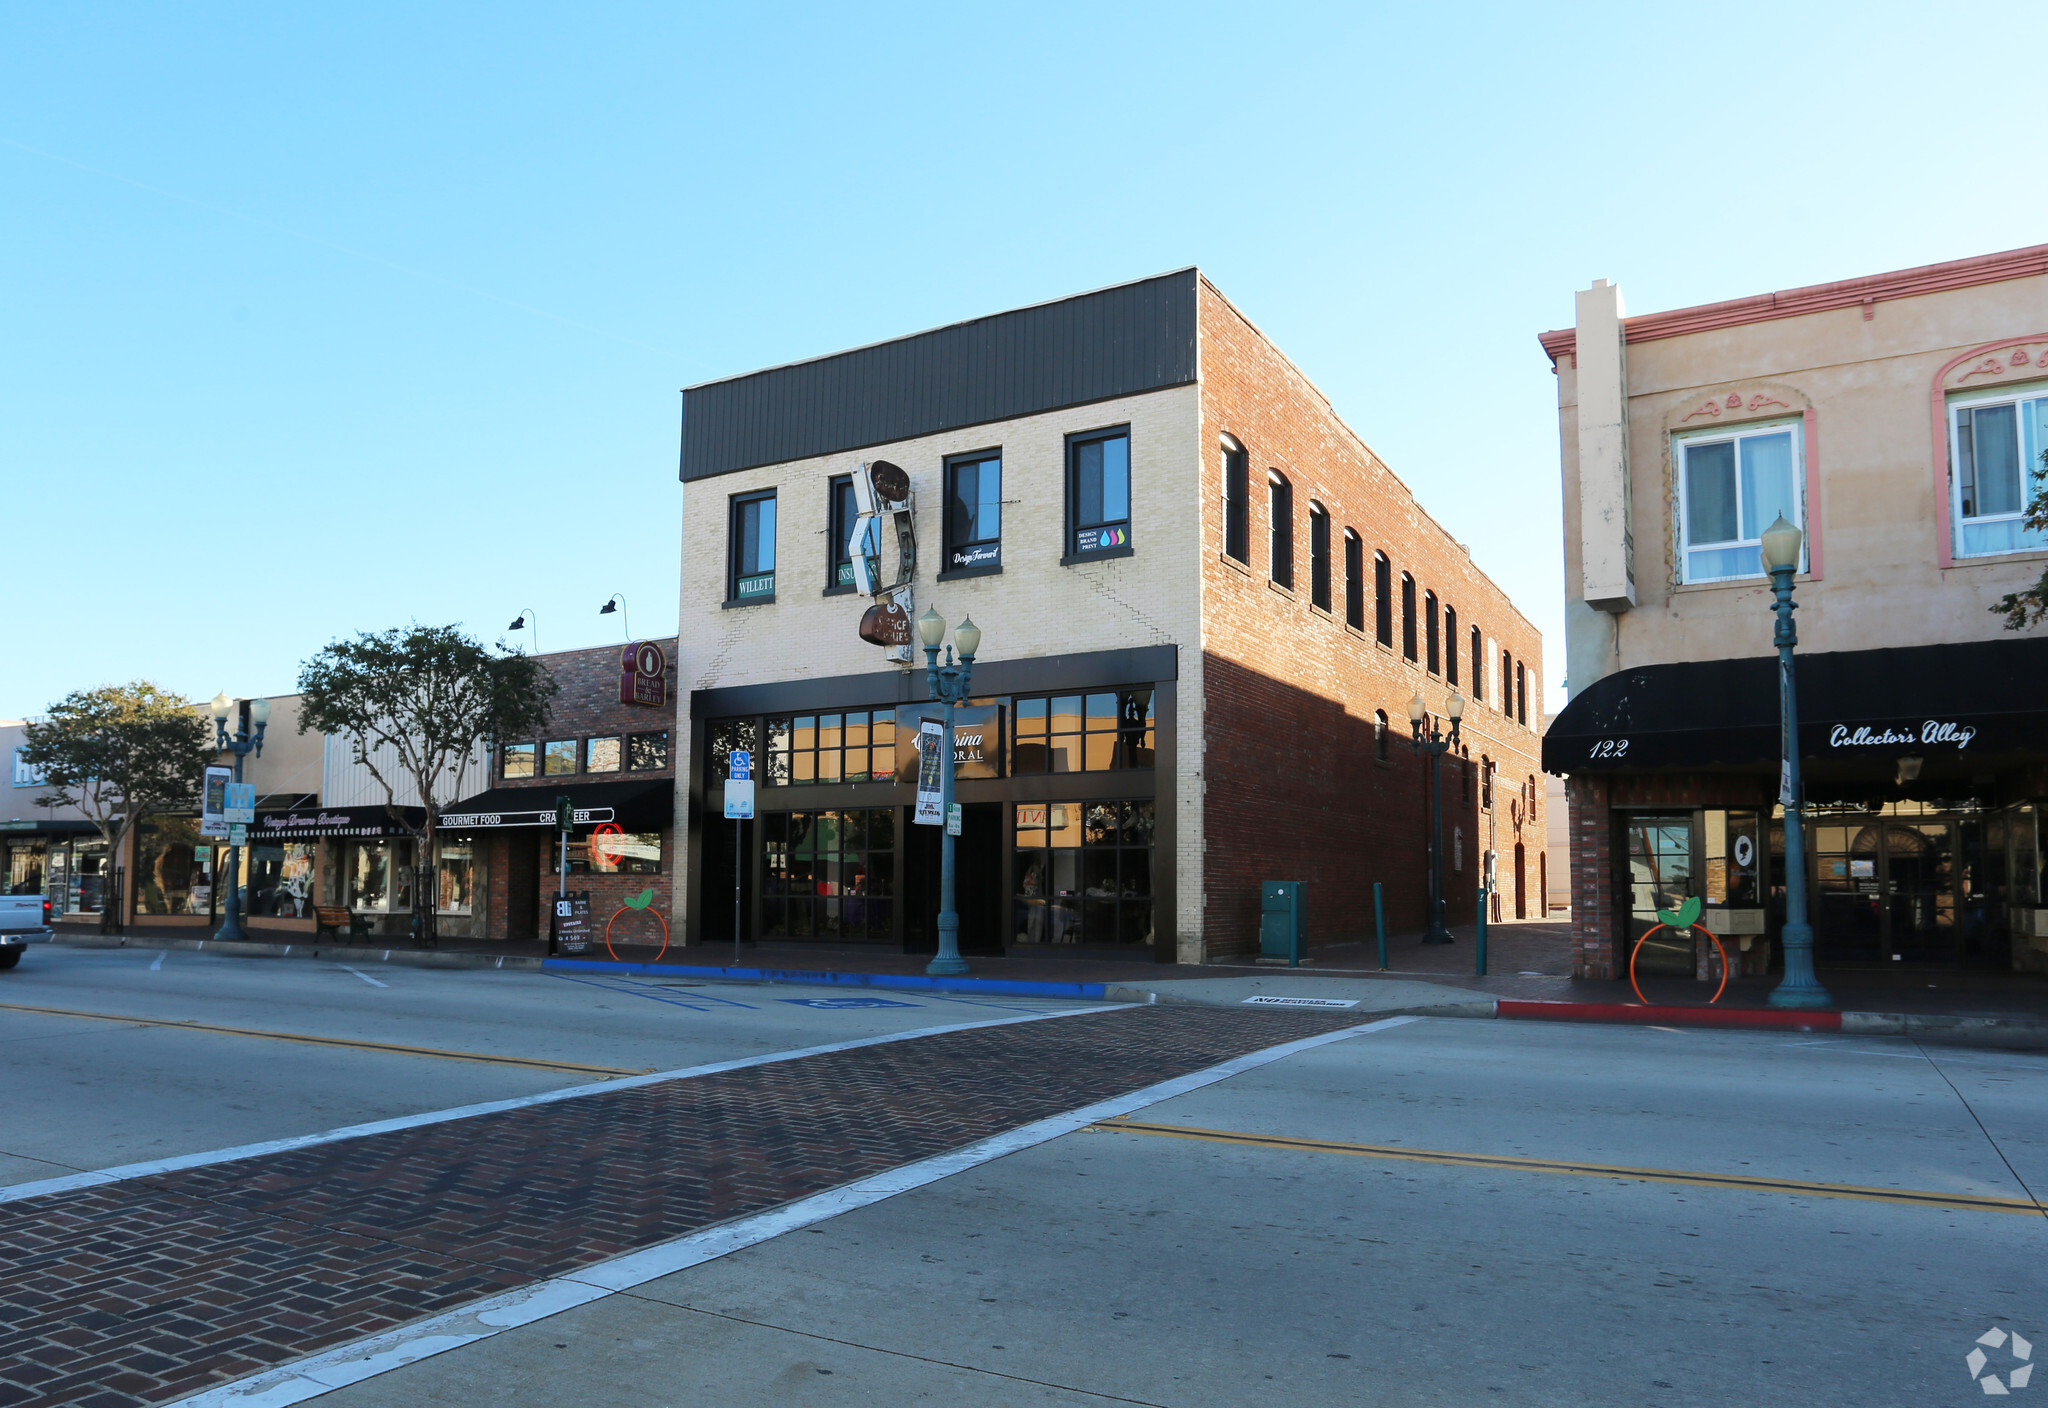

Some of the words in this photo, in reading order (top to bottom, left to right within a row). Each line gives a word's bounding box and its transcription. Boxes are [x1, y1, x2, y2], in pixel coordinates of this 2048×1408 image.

[739, 577, 774, 593] WILLETT
[638, 677, 660, 689] BREAD
[636, 692, 662, 703] BARLEY
[1830, 723, 1917, 748] Collector's
[1921, 719, 1976, 749] Alley
[1589, 739, 1629, 758] 122
[442, 816, 479, 826] GOURMET
[480, 815, 501, 825] FOOD
